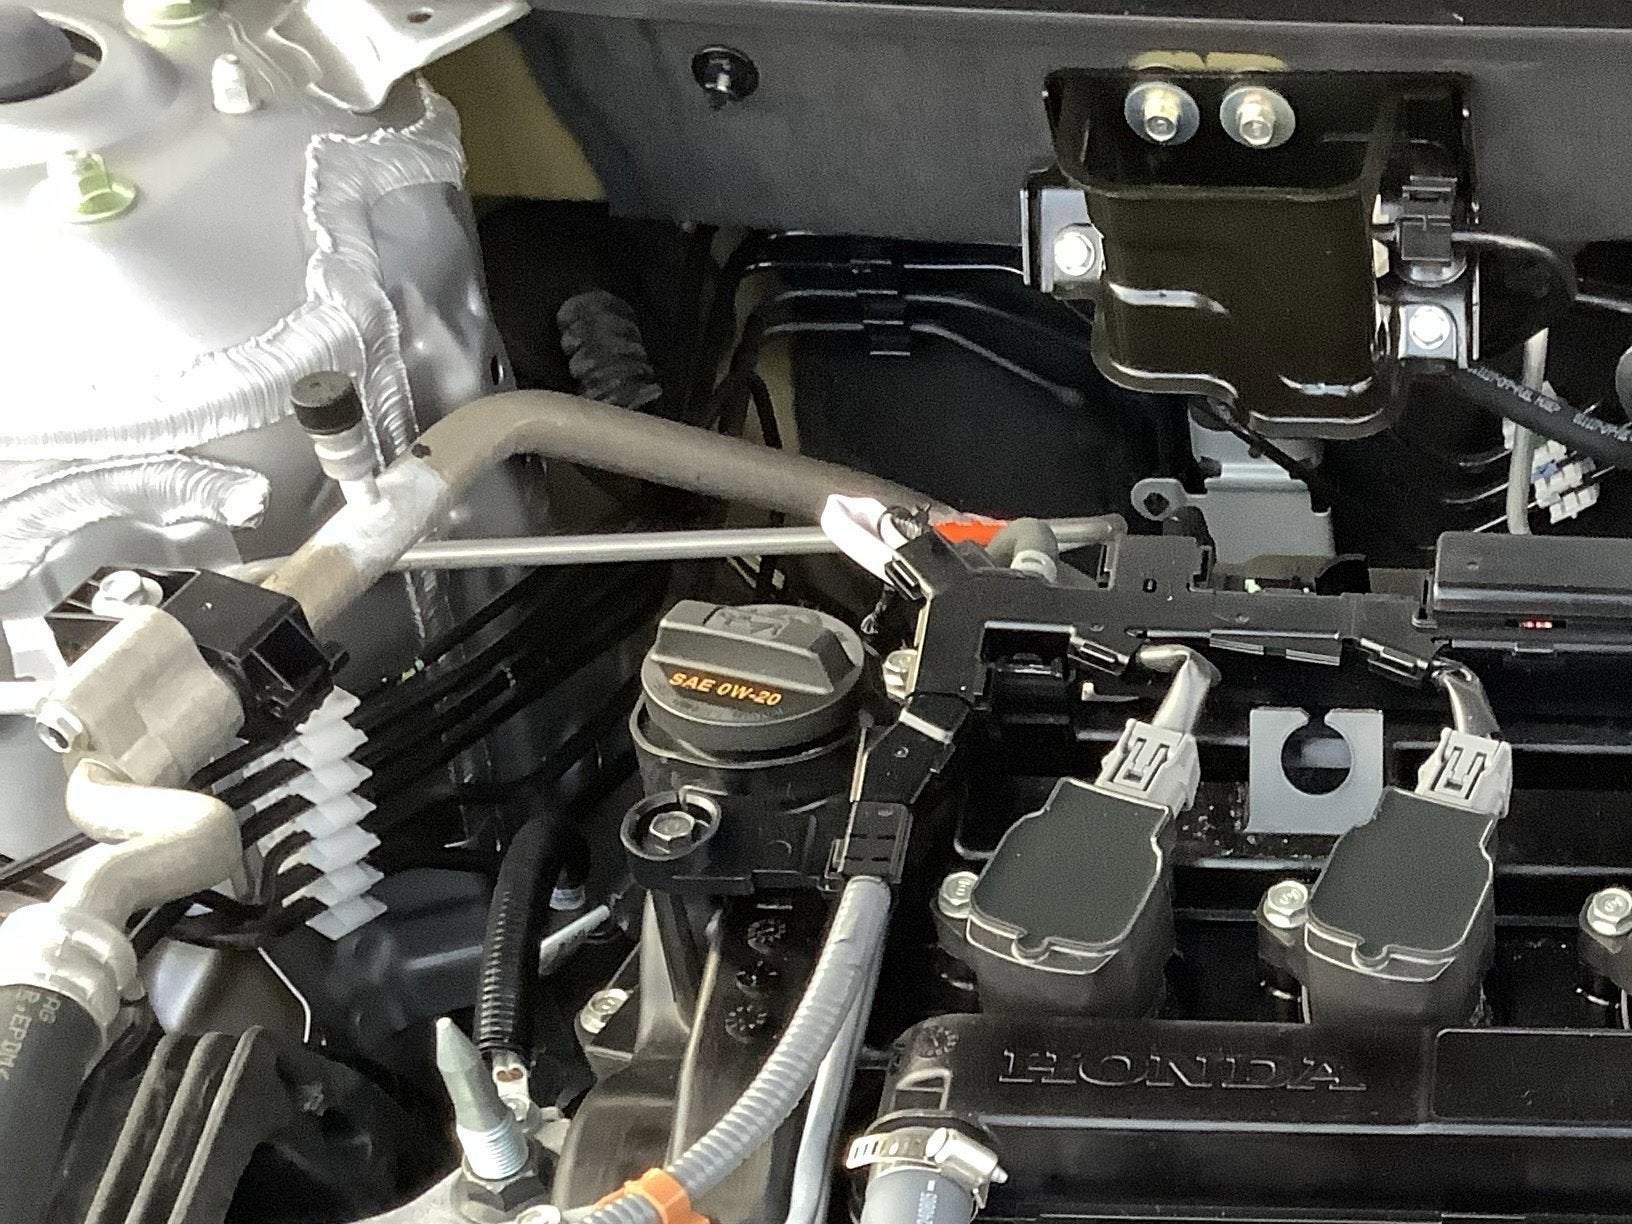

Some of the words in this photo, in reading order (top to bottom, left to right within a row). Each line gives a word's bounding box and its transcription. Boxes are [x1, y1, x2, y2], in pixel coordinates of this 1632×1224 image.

[669, 672, 716, 693] SAE
[716, 683, 782, 706] 0W-20
[999, 1049, 1367, 1092] HONDA
